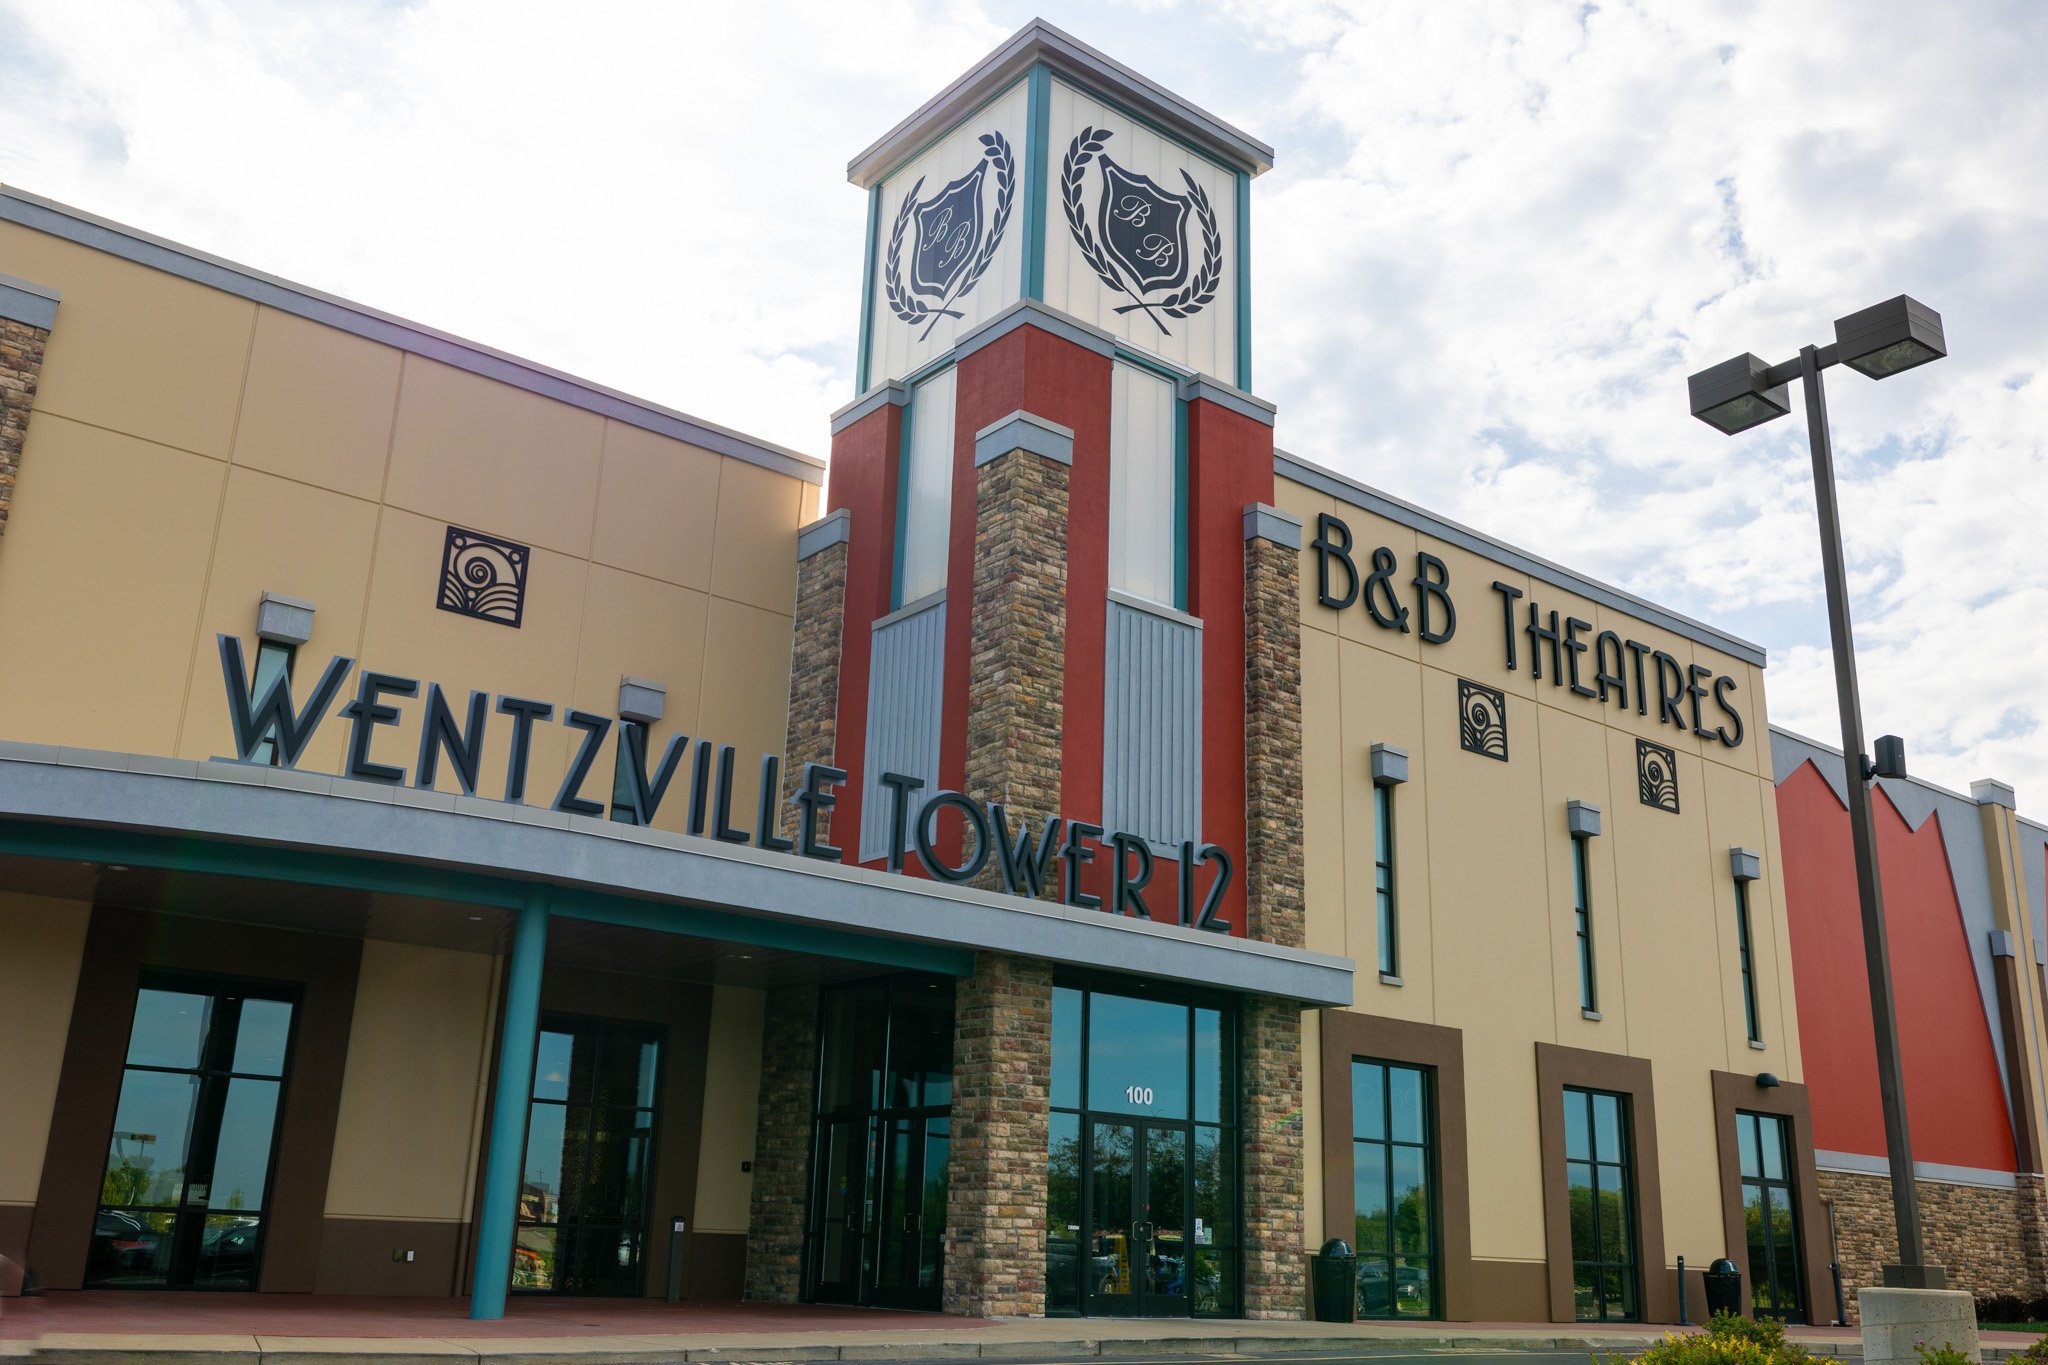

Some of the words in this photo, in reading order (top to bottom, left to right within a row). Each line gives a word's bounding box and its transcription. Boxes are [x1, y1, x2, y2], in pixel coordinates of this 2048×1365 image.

[1312, 512, 1457, 645] B&B
[1492, 580, 1745, 749] THEATRES
[216, 632, 847, 860] WENTZVILLE
[883, 771, 1154, 921] TOWER
[1178, 837, 1233, 935] 12
[1125, 1085, 1153, 1105] 100
